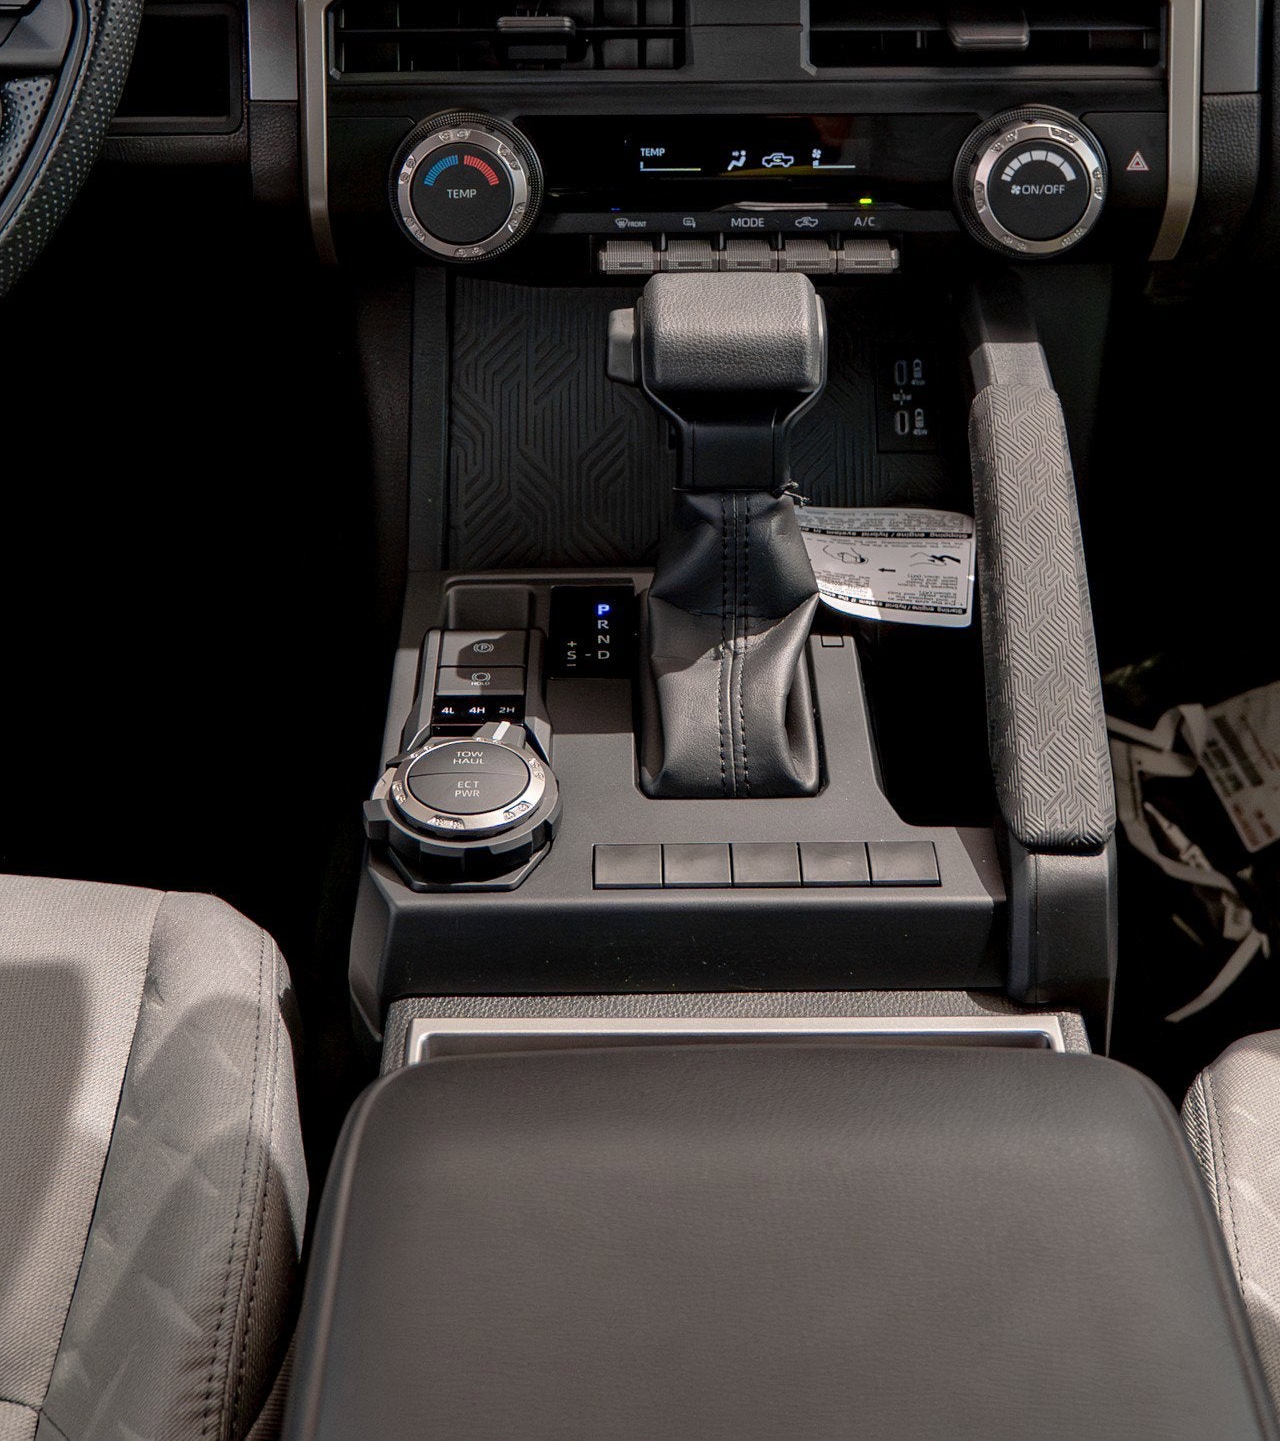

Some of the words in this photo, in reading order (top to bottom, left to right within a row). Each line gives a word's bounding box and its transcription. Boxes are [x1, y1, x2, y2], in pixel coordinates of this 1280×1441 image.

[640, 147, 666, 157] TEMP
[446, 188, 477, 198] TEMP
[1022, 184, 1065, 195] ON/OFF
[627, 220, 647, 228] FRONT
[731, 217, 765, 228] MODE
[854, 216, 876, 227] A/C
[598, 604, 610, 615] P
[885, 601, 908, 610] hybrid
[910, 604, 935, 612] engine
[936, 606, 963, 615] Starting
[597, 620, 609, 629] R
[598, 635, 610, 644] N
[567, 651, 577, 660] S
[597, 650, 610, 660] D
[441, 707, 455, 715] 4L
[457, 781, 479, 789] ECT
[454, 790, 481, 798] PWR
